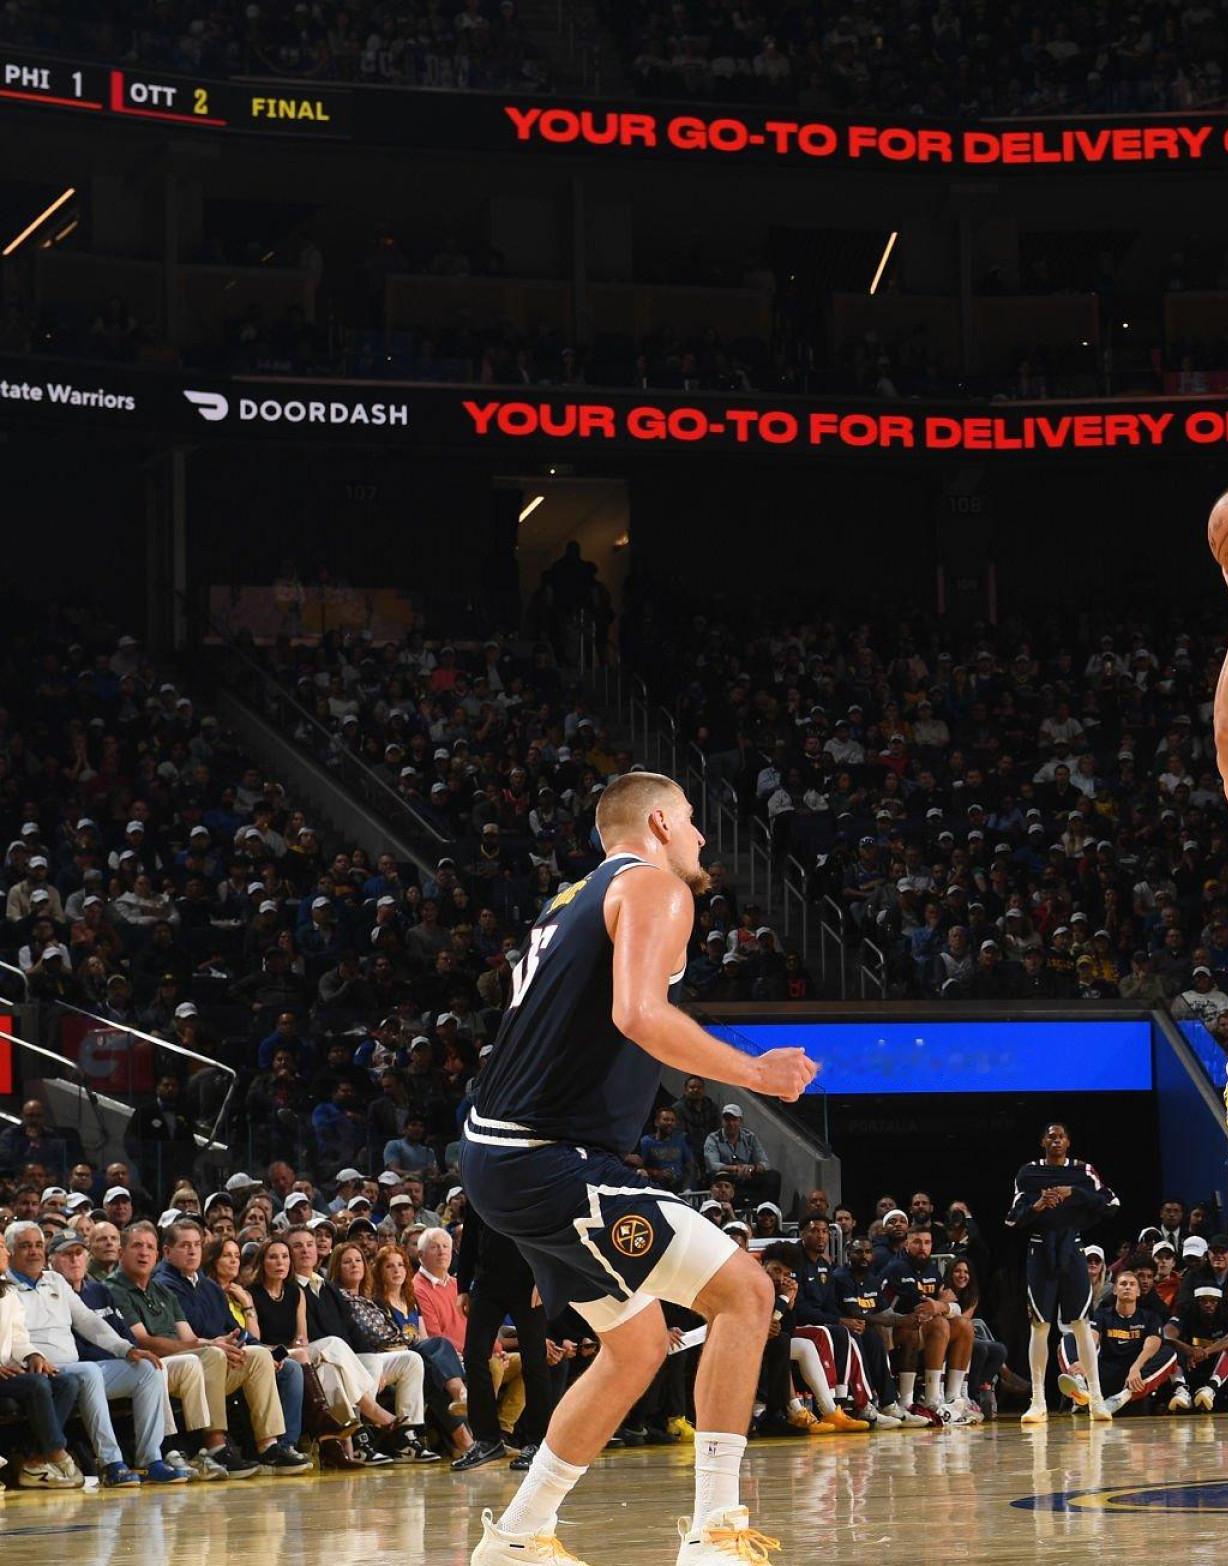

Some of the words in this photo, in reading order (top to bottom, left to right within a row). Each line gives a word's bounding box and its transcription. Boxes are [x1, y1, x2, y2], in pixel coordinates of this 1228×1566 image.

[5, 64, 50, 89] PHI
[72, 71, 82, 97] 1
[130, 82, 177, 107] OTT
[194, 88, 208, 115] 2
[252, 97, 330, 121] FINAL
[506, 107, 656, 146] YOUR
[668, 117, 837, 156] GO-TO
[849, 127, 952, 162] FOR
[964, 127, 1211, 163] DELIVERY
[0, 379, 43, 401] tate
[46, 382, 135, 411] Warriors
[239, 399, 408, 426] DOORDASH
[464, 402, 615, 437] YOUR
[627, 407, 797, 443] GO-TO
[810, 413, 914, 447] FOR
[926, 413, 1173, 449] DELIVERY
